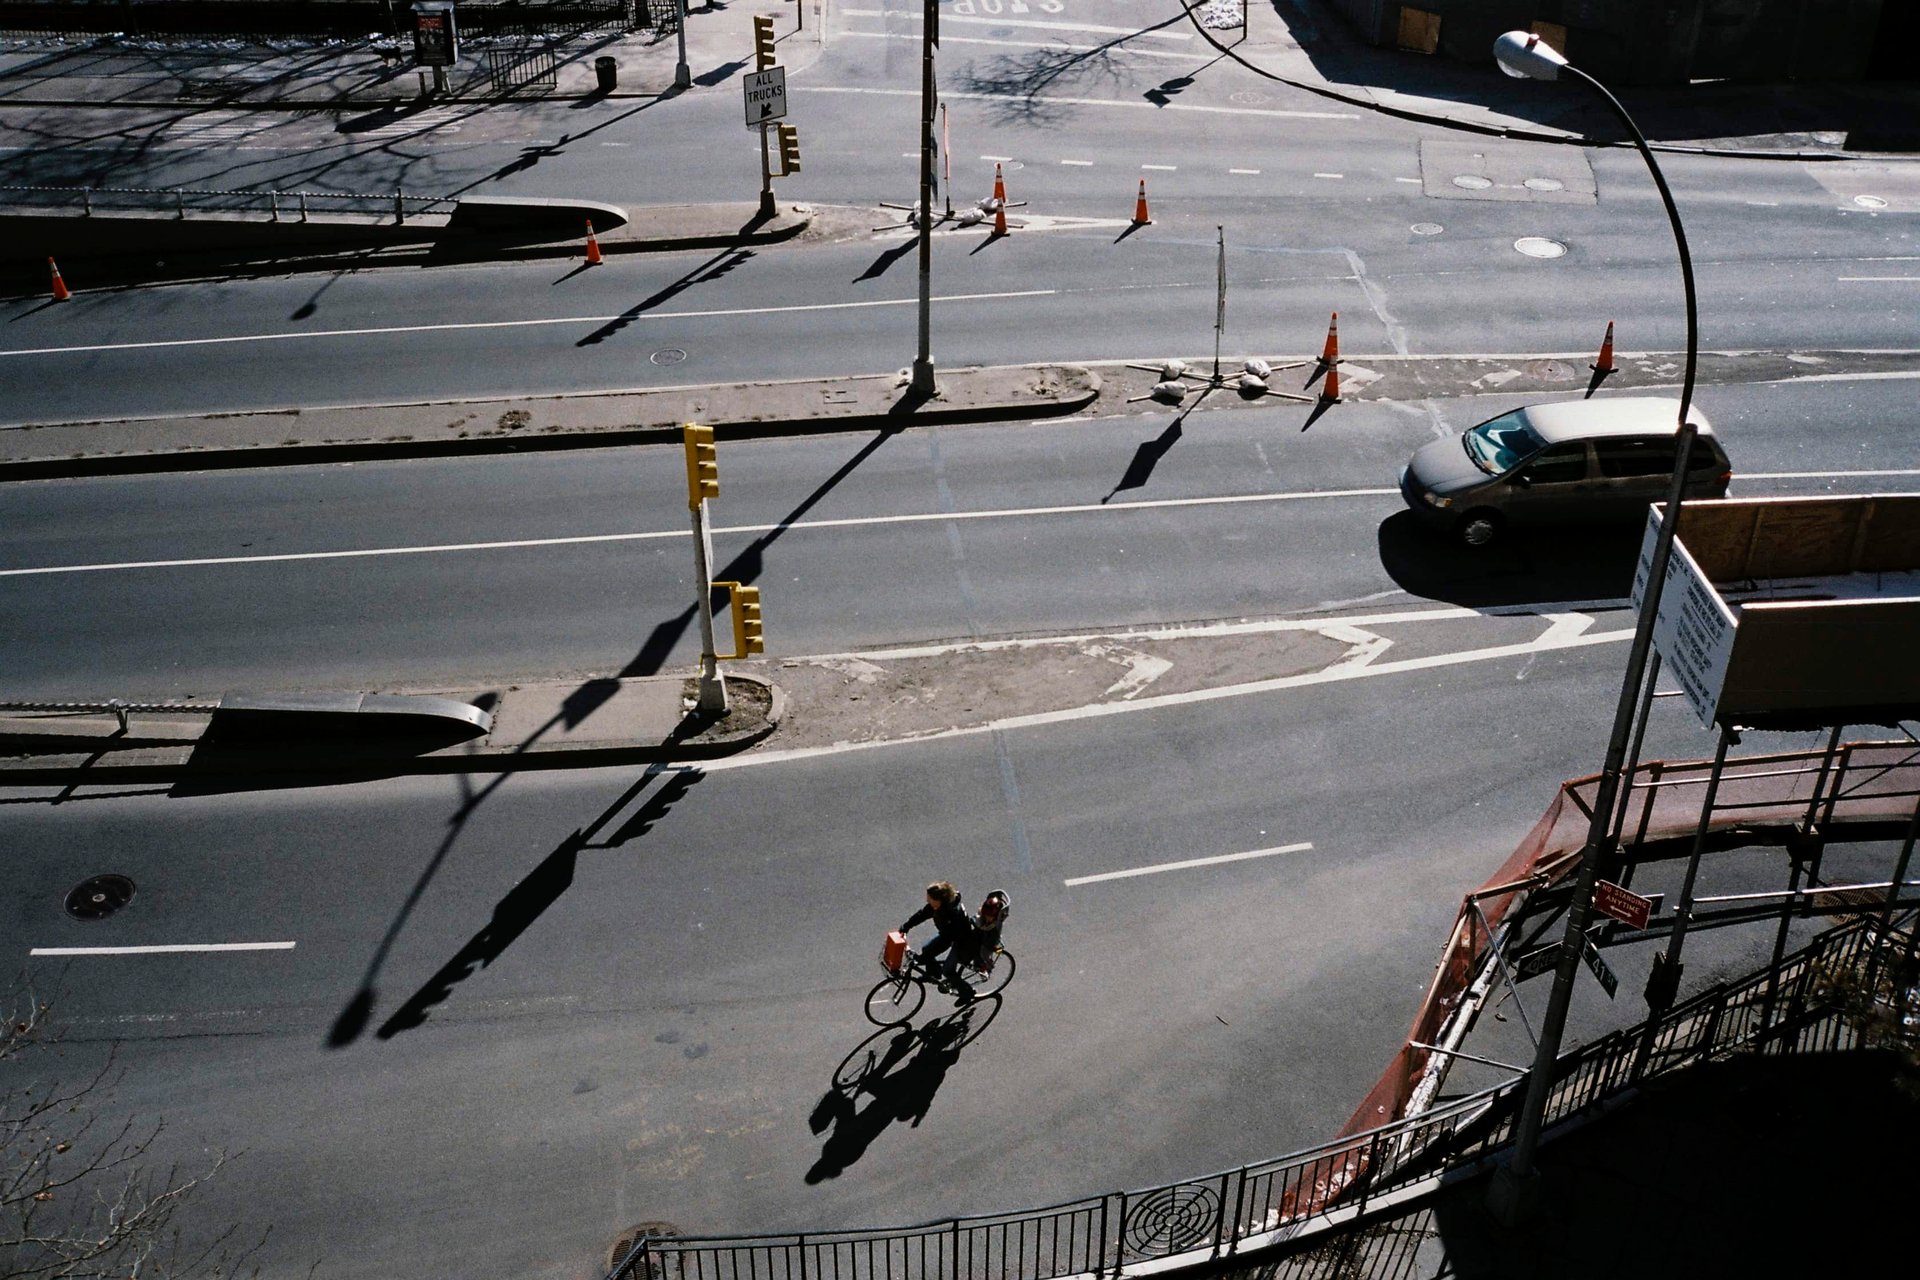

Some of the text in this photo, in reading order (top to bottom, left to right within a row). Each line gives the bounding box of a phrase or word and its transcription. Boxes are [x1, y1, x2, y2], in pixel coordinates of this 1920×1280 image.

[756, 73, 773, 87] ALL
[747, 85, 783, 103] TRUCKS
[1602, 884, 1647, 908] NO STANDING
[1605, 895, 1640, 915] ANYTIME
[1531, 953, 1552, 969] ONE
[1582, 941, 1591, 959] E
[1592, 958, 1605, 981] 41
